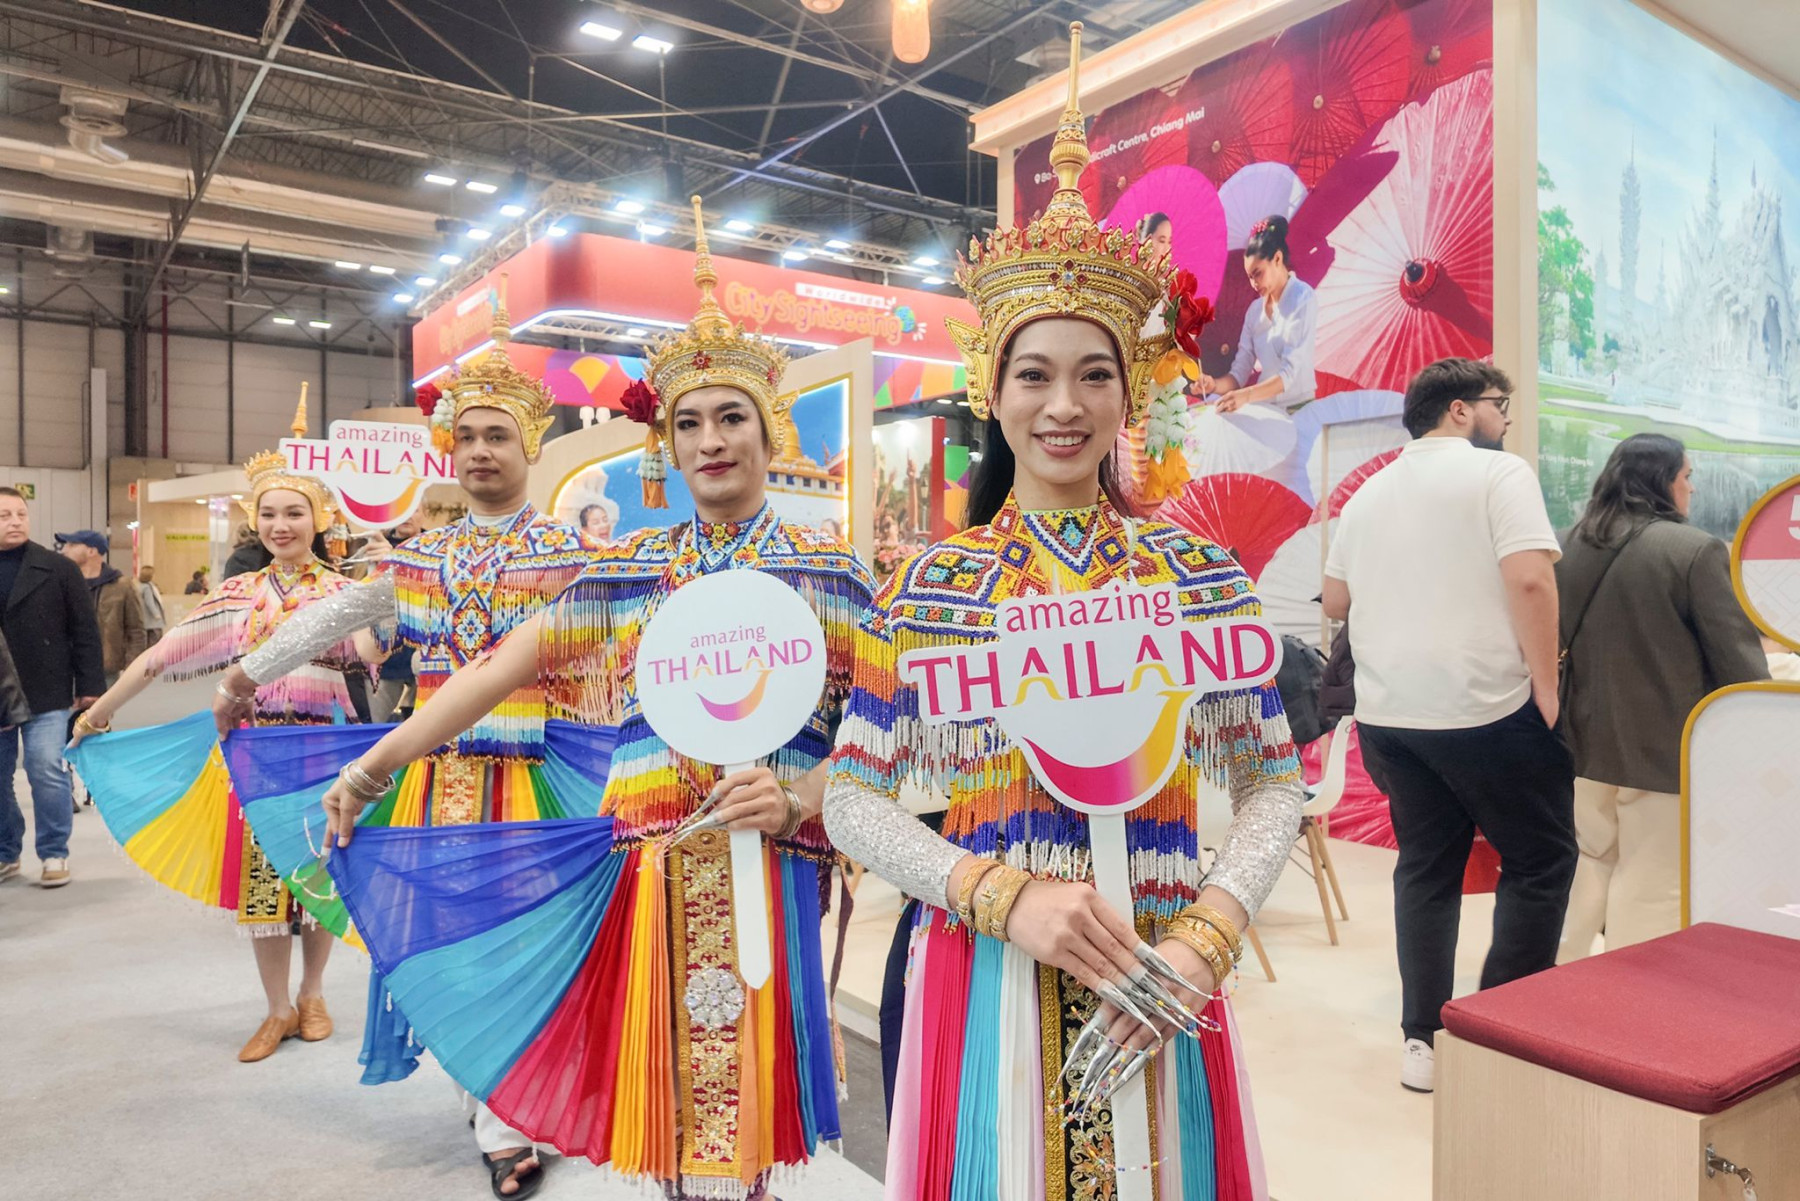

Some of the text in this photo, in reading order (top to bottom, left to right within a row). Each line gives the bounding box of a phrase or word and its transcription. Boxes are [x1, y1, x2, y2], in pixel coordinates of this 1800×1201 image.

[1117, 133, 1149, 151] Centre,
[1150, 117, 1185, 138] Chiang
[1185, 106, 1205, 125] Mai
[336, 426, 423, 449] amazing
[1005, 582, 1175, 633] amazing
[690, 625, 767, 649] amazing
[648, 637, 813, 685] THAILAND
[907, 623, 1276, 717] THAILAND
